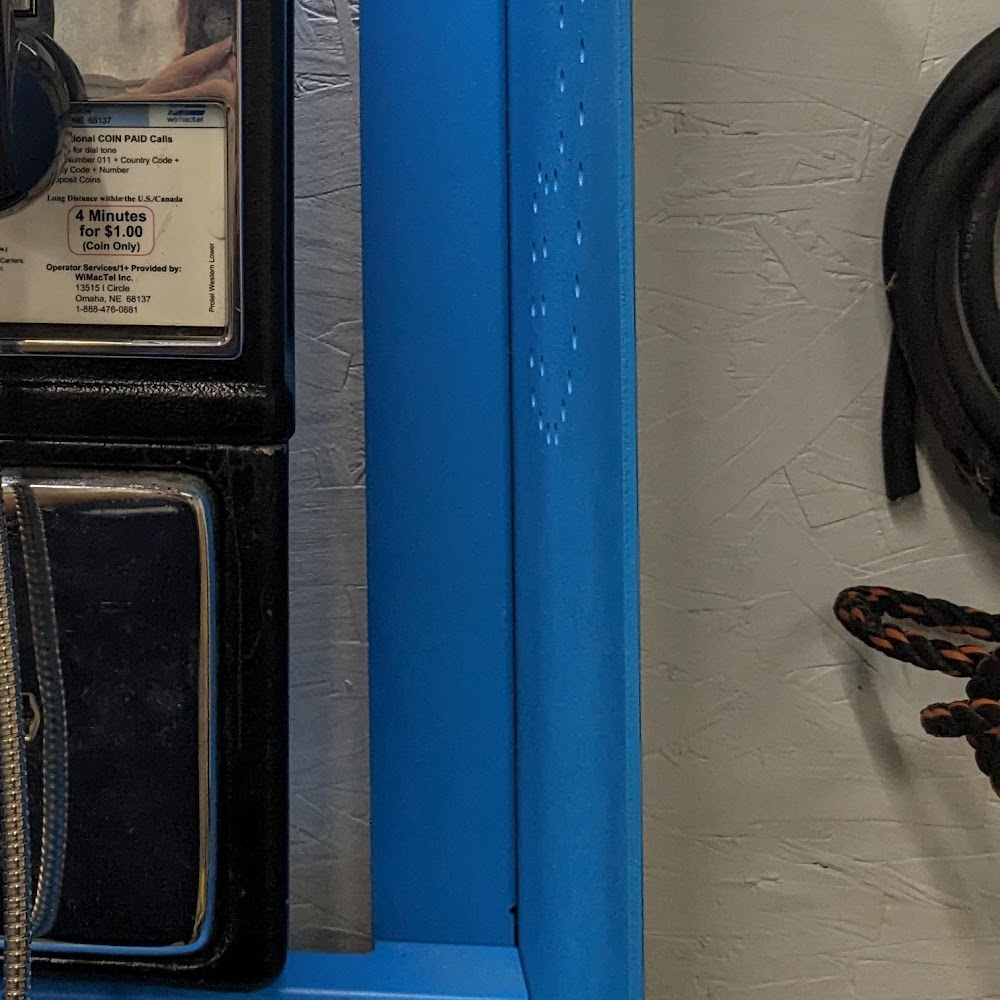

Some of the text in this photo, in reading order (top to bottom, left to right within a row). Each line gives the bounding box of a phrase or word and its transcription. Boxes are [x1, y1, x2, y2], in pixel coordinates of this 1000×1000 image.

[97, 134, 173, 143] COIN PAID Calls
[120, 156, 150, 164] Country
[75, 209, 147, 222] 4 Minutes
[80, 224, 143, 238] for $1.00
[82, 241, 140, 252] (Coin Only)
[46, 264, 182, 274] Operator Services/1+ Provided by:
[107, 284, 130, 292] Circle
